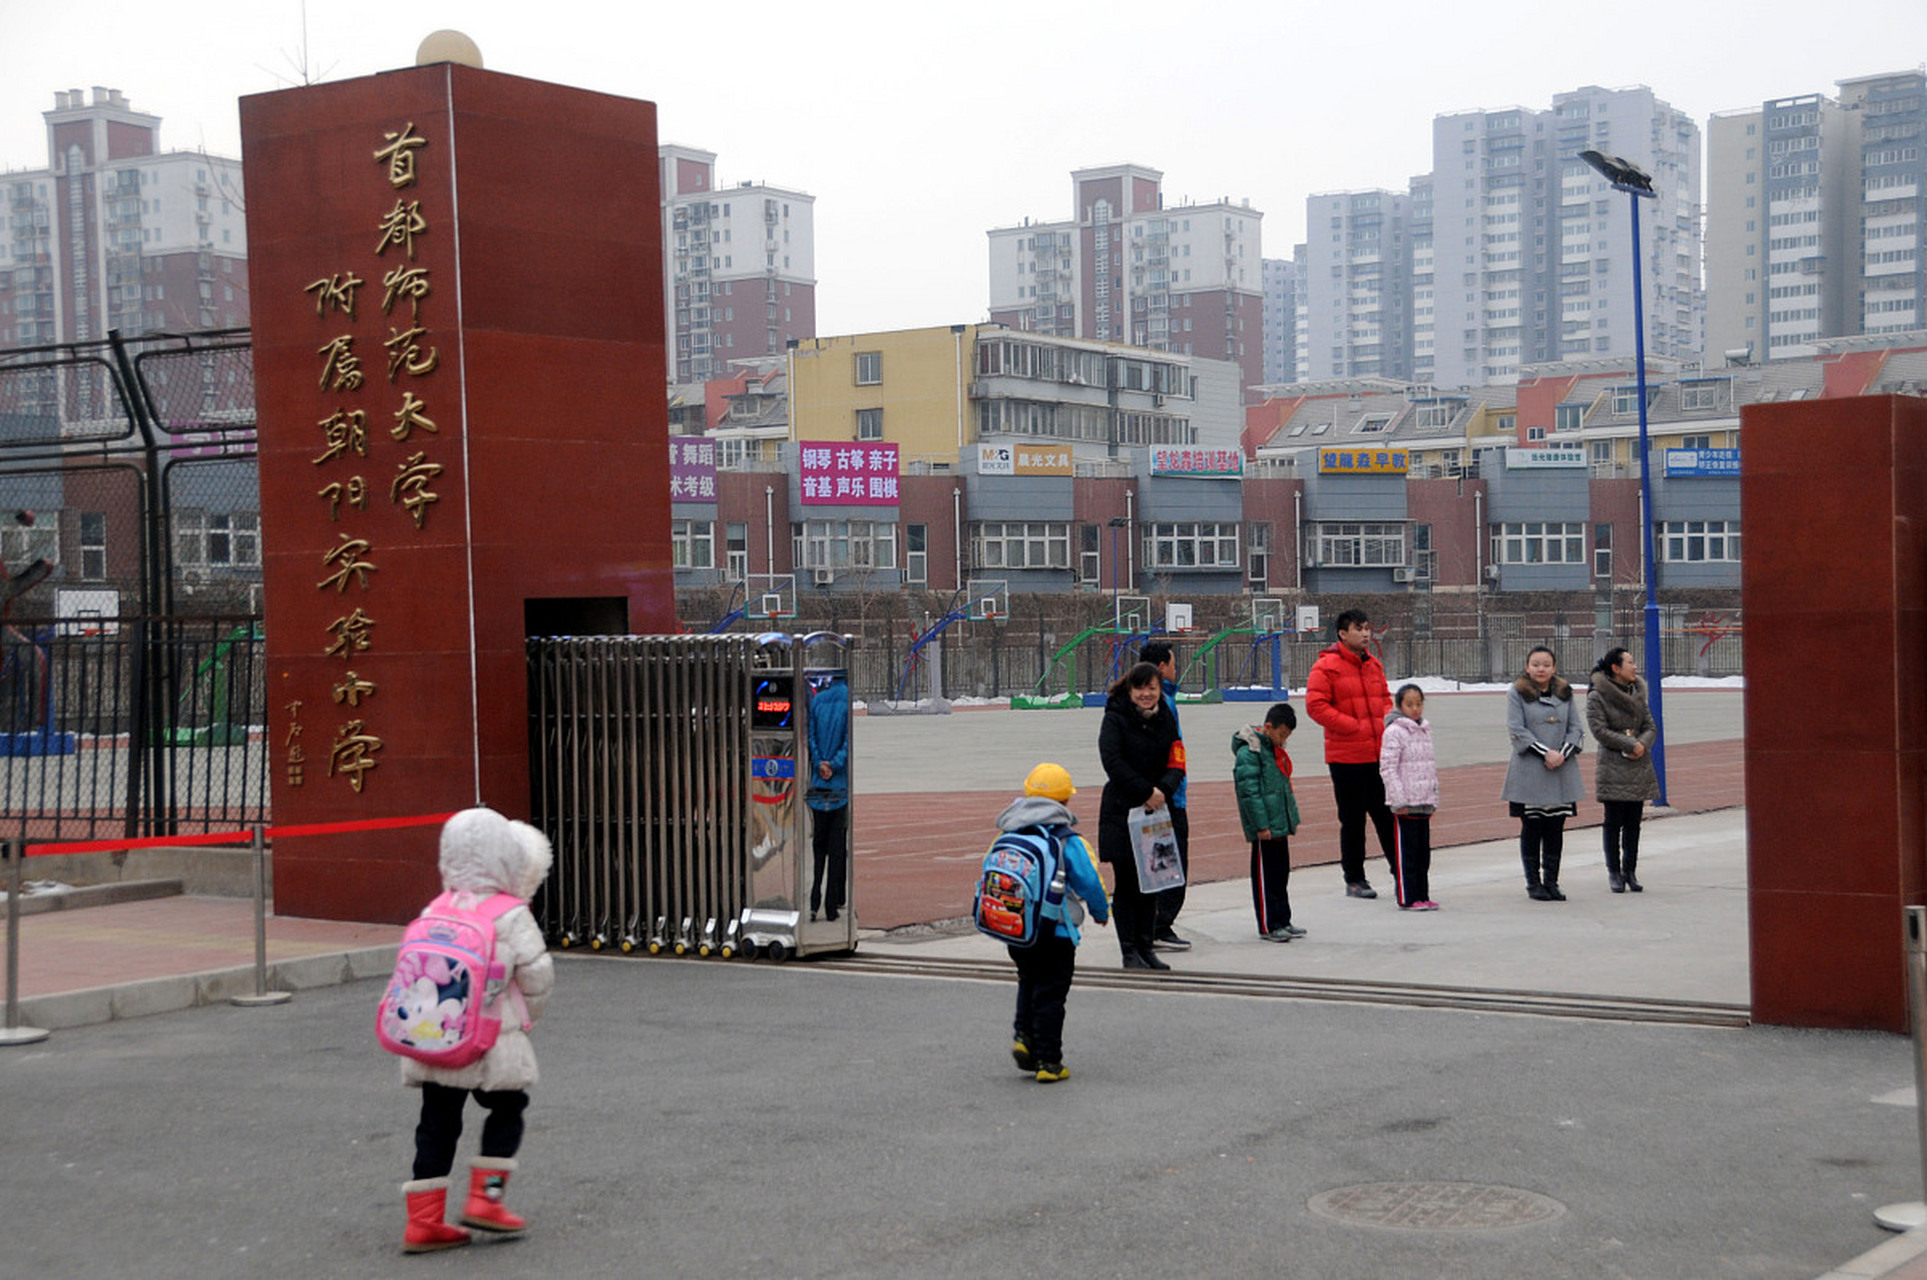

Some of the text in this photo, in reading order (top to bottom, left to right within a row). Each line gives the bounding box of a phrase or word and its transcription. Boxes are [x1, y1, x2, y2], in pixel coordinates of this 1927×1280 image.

[373, 122, 444, 530] 首都师范大学
[682, 443, 714, 466] 舞蹈
[802, 448, 897, 471] 钢琴 古筝 亲子
[982, 448, 1009, 461] M&G
[1017, 453, 1069, 467] 晨光文具
[670, 475, 715, 497] 术考级
[802, 475, 898, 499] 音基 声乐 围棋
[303, 271, 384, 793] 附属朝阳实验小学
